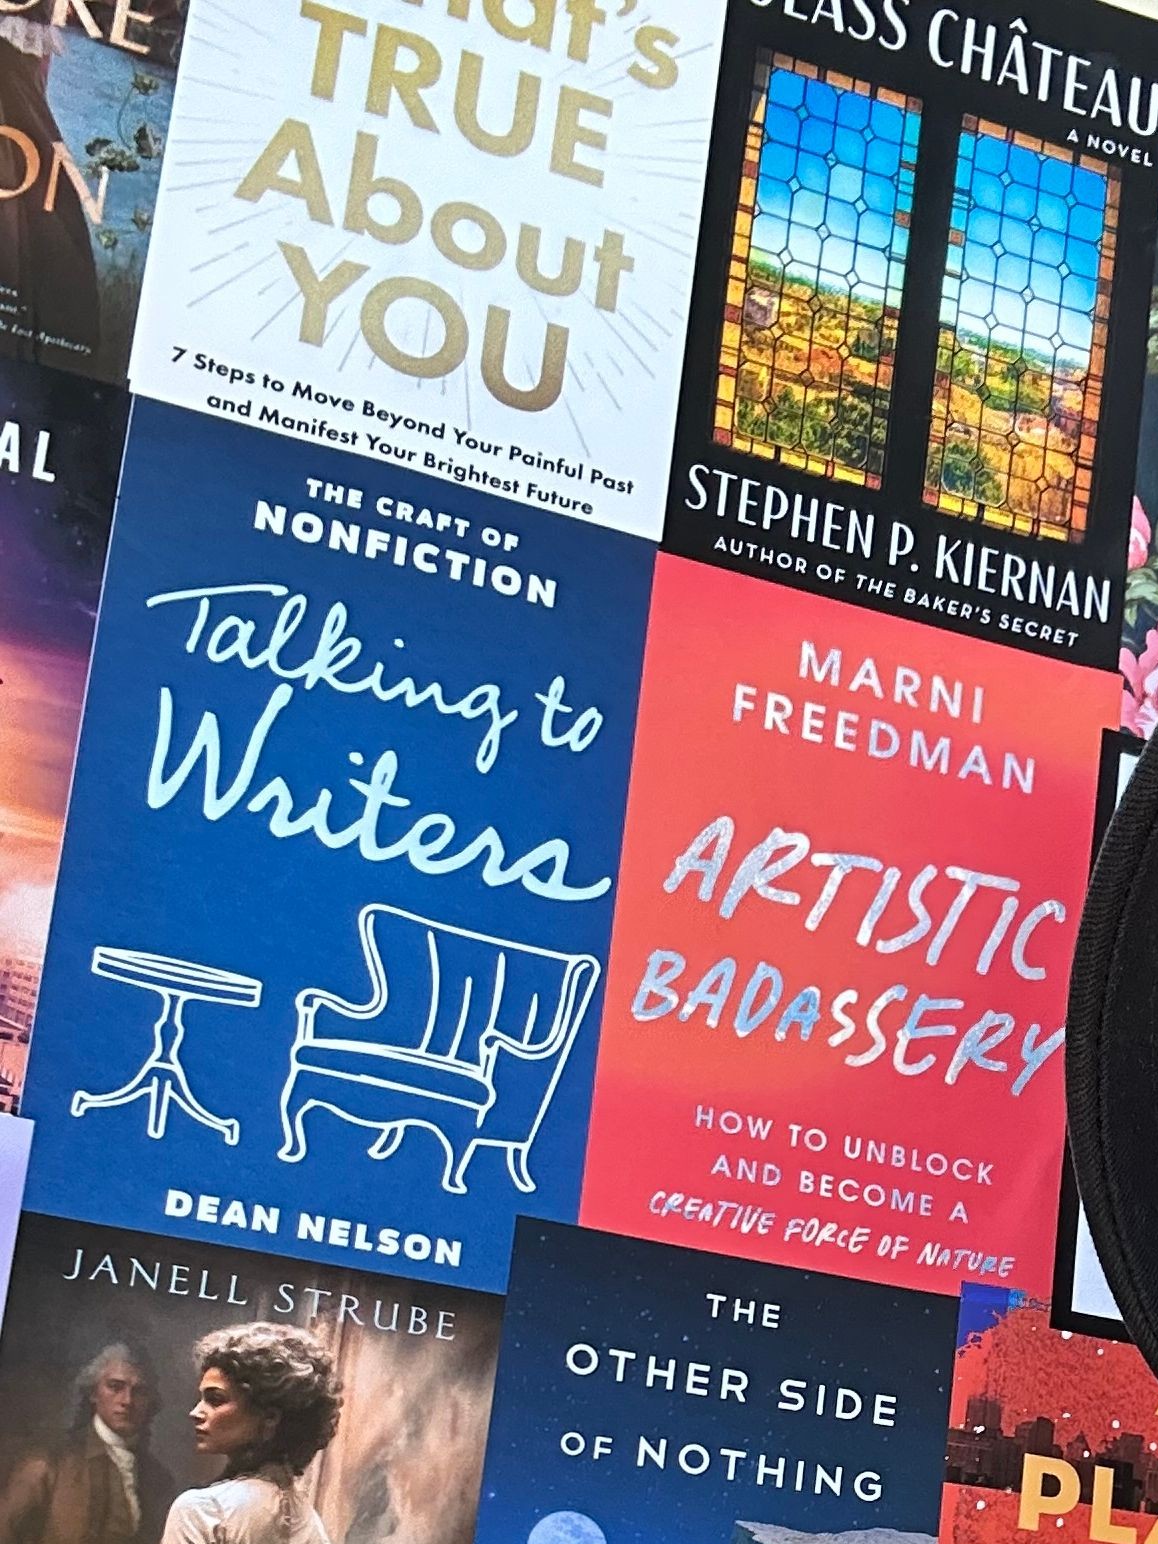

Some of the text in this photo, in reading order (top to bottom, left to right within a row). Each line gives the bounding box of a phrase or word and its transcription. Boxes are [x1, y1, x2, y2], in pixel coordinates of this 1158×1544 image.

[300, 2, 613, 189] TRUE
[1087, 134, 1155, 168] NOVEL
[233, 117, 636, 313] About
[277, 240, 570, 413] YOU
[171, 346, 636, 497] 7 Steps to Move Beyond Your Painful Past
[206, 393, 596, 517] and Manifest Your Brightest Future
[252, 499, 558, 609] NONFICTION
[305, 477, 522, 552] THE CRAFT OF
[684, 463, 1113, 624] STEPHEN P. KIERNAN
[713, 535, 809, 575] AUTHOR
[815, 564, 847, 585] OF
[855, 573, 899, 599] THE
[997, 613, 1081, 649] SECRET
[147, 584, 603, 774] Talking to
[798, 639, 987, 725] MARNI
[147, 683, 612, 901] Writers
[732, 683, 1035, 794] FREEDMAN
[663, 816, 1066, 981] ARTISTIC
[631, 948, 1066, 1096] BADASSERY
[695, 1104, 995, 1186] HOW TO UNBLOCK
[710, 1153, 970, 1225] AND BECOME A
[164, 1187, 464, 1269] DEAN NELSON
[648, 1189, 1017, 1279] CREATIVE FORCE OF NATURE
[63, 1247, 458, 1342] JANELL STRUBE
[705, 1292, 782, 1330] THE
[566, 1343, 898, 1428] OTHER SIDE
[560, 1430, 883, 1503] OF NOTHING
